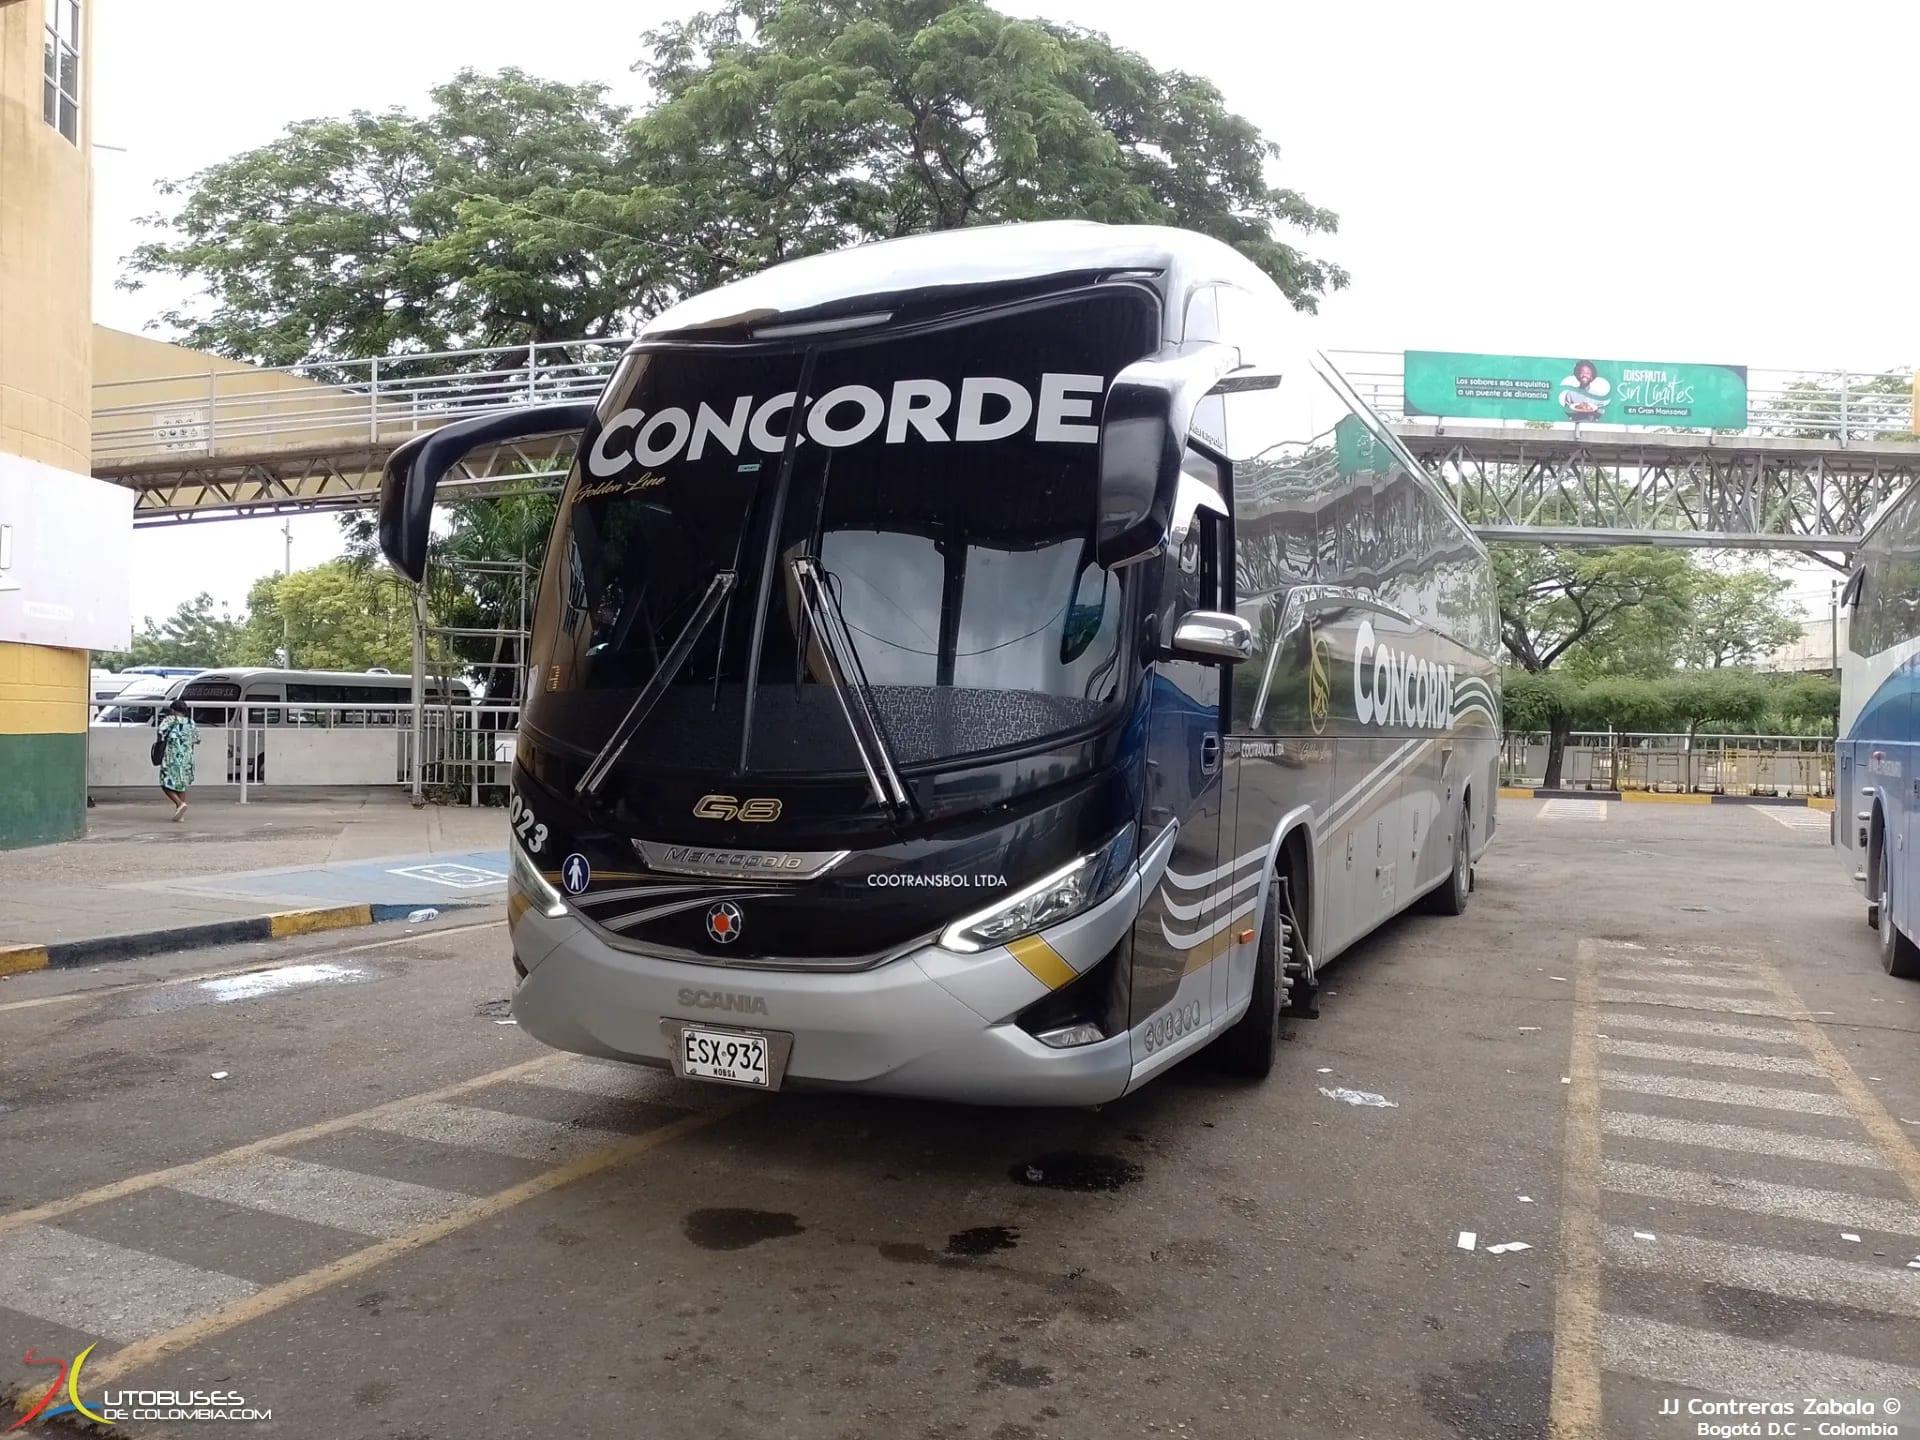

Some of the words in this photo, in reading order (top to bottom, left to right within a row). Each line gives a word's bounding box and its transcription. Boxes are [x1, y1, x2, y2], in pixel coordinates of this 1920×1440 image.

[1470, 378, 1498, 386] sabores
[1515, 380, 1550, 389] exquisitos
[1475, 390, 1501, 398] puente
[1514, 391, 1548, 399] distancia
[588, 373, 1104, 477] CONCORDE
[571, 479, 622, 504] Golden
[623, 471, 667, 494] Line
[1353, 620, 1455, 730] CONCORDE
[693, 795, 783, 822] G8
[664, 847, 803, 870] Marcopolo
[867, 874, 970, 888] COOTRANSBOL
[974, 874, 1008, 887] LTDA
[677, 988, 769, 1016] SCANIA
